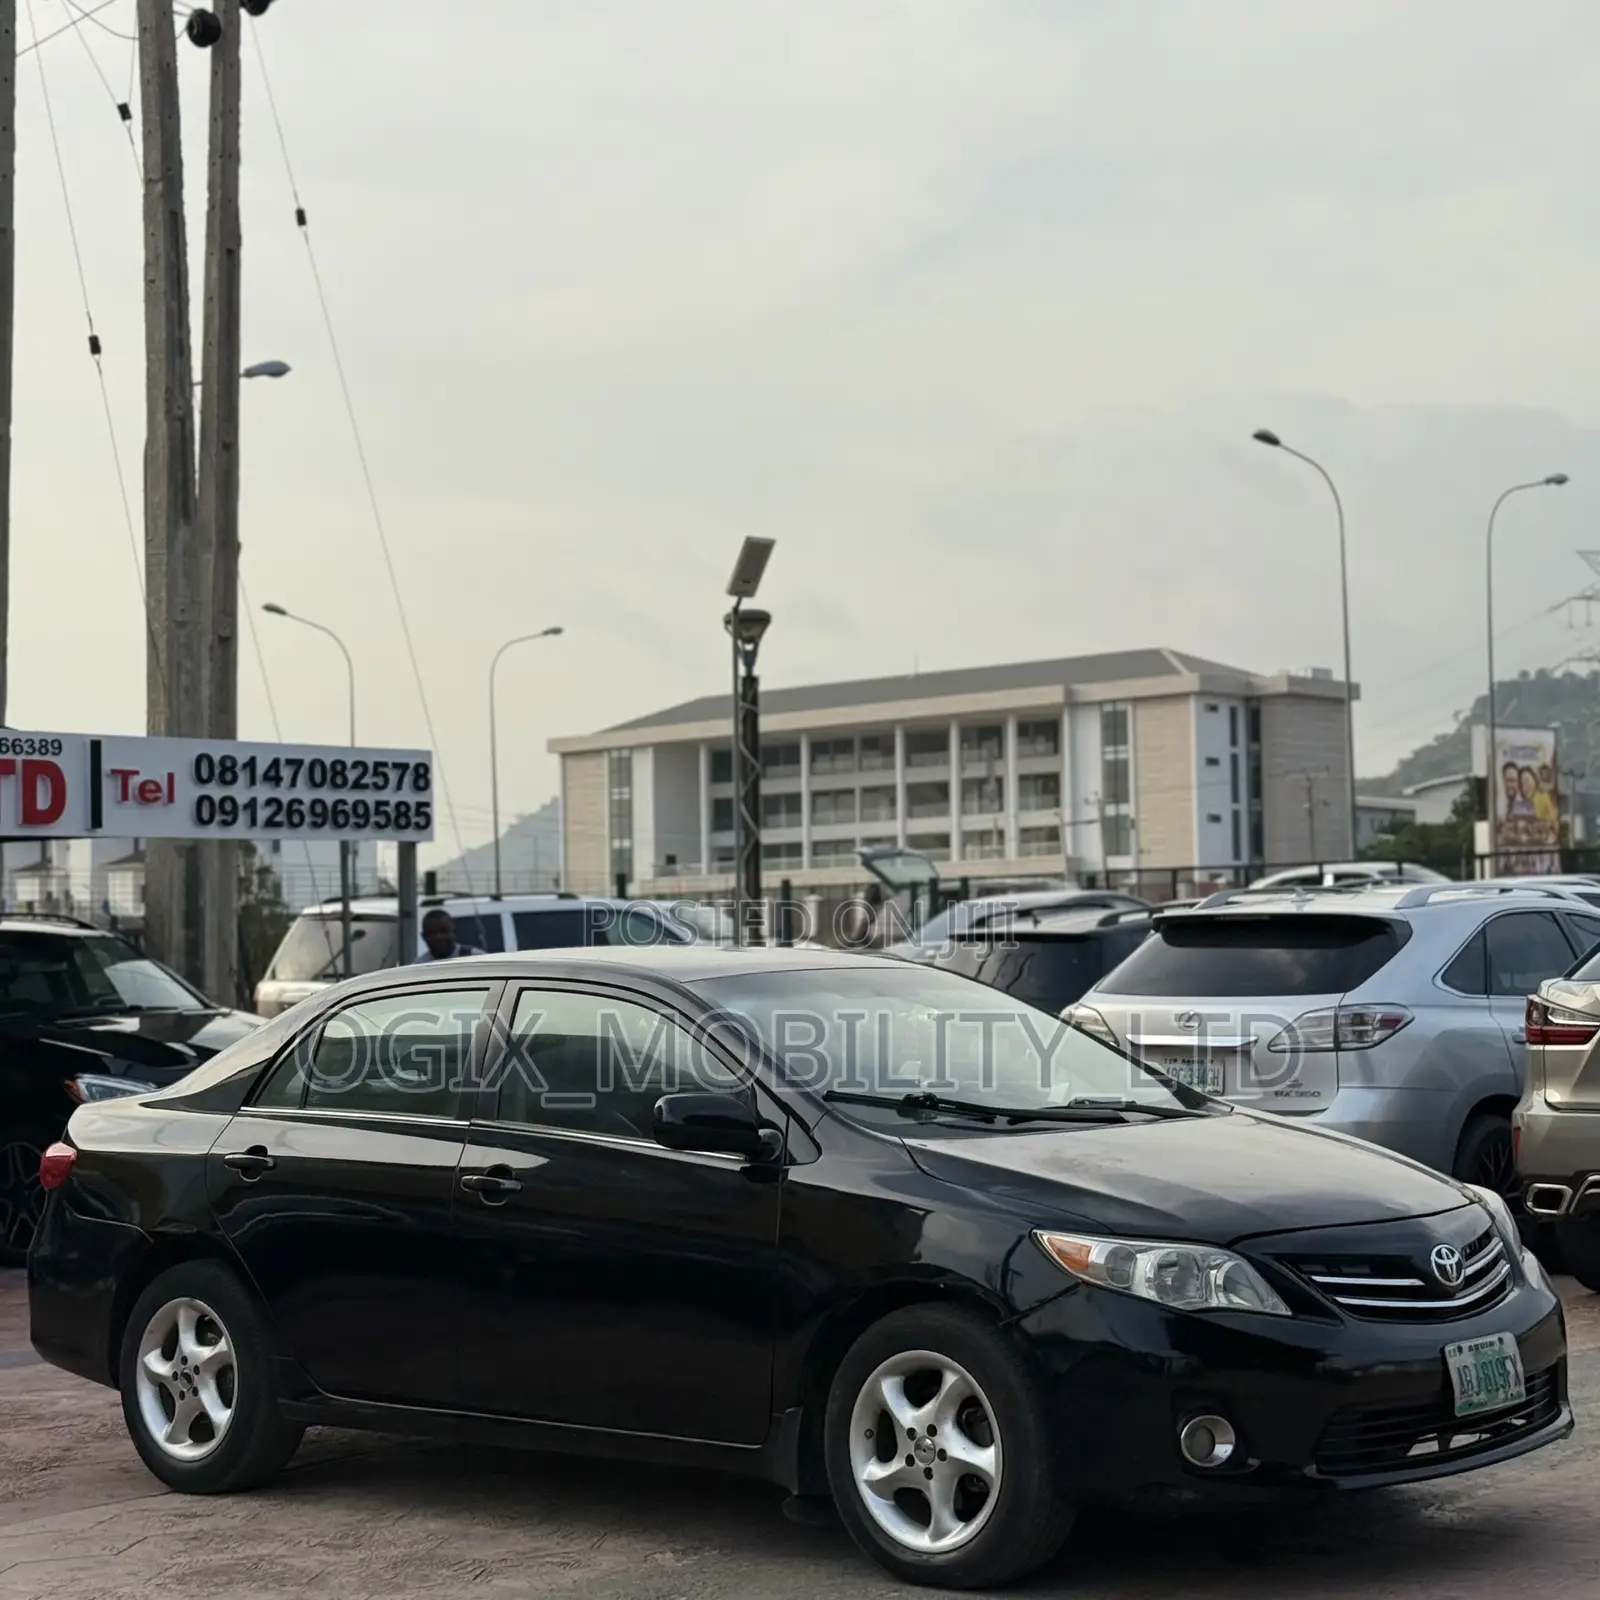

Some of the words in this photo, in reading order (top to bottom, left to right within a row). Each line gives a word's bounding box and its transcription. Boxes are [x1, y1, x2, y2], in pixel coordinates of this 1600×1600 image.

[110, 769, 175, 804] Tel
[194, 753, 430, 791] 08147082578
[195, 794, 431, 830] 09126969585
